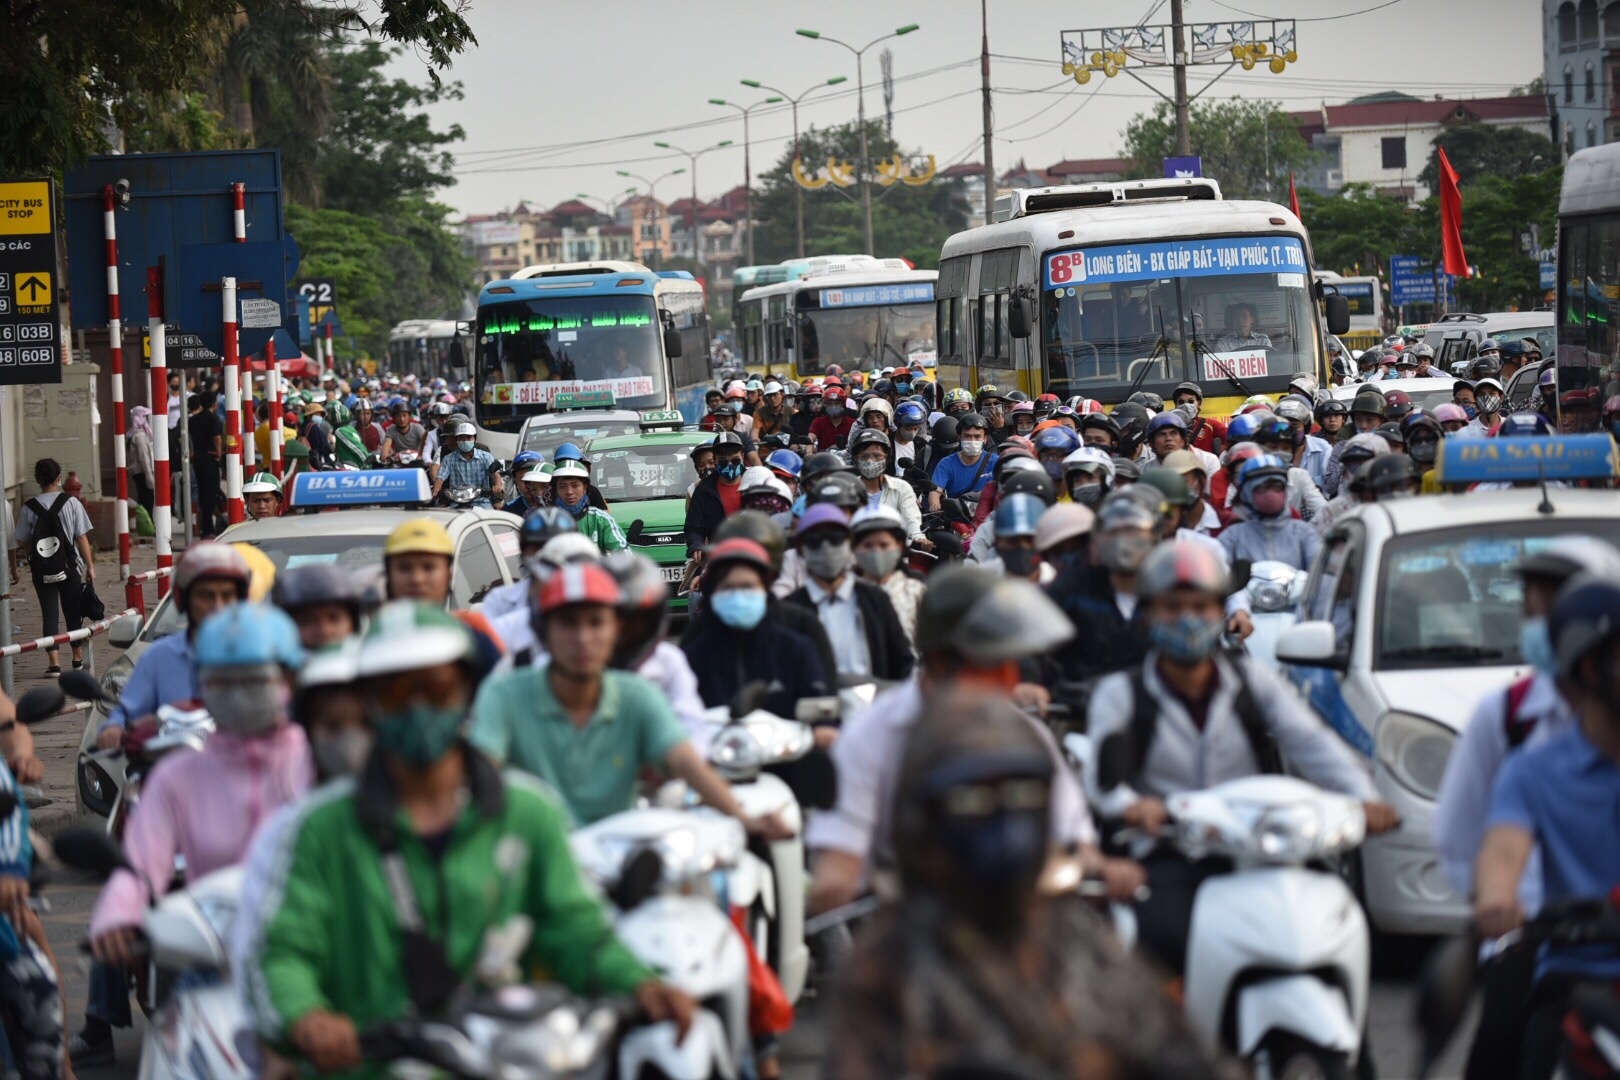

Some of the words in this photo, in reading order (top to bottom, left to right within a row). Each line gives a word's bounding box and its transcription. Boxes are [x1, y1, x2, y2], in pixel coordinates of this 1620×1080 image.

[24, 199, 42, 207] BUS
[8, 210, 33, 218] STOP
[9, 240, 31, 250] CÁC
[1087, 256, 1115, 275] LONG
[1117, 250, 1141, 273] BIÊN
[1150, 252, 1165, 271] BX
[1167, 247, 1191, 270] GIÁP
[1241, 242, 1268, 266] PHÚC
[1271, 246, 1284, 266] (T.
[299, 283, 332, 302] C2
[21, 326, 49, 339] 03B
[183, 336, 194, 345] 16
[22, 349, 50, 362] 60B
[183, 350, 194, 358] 48
[1206, 358, 1236, 379] LONG
[1239, 354, 1266, 377] BIÊN
[307, 477, 337, 489] BA
[341, 475, 385, 488] SAO
